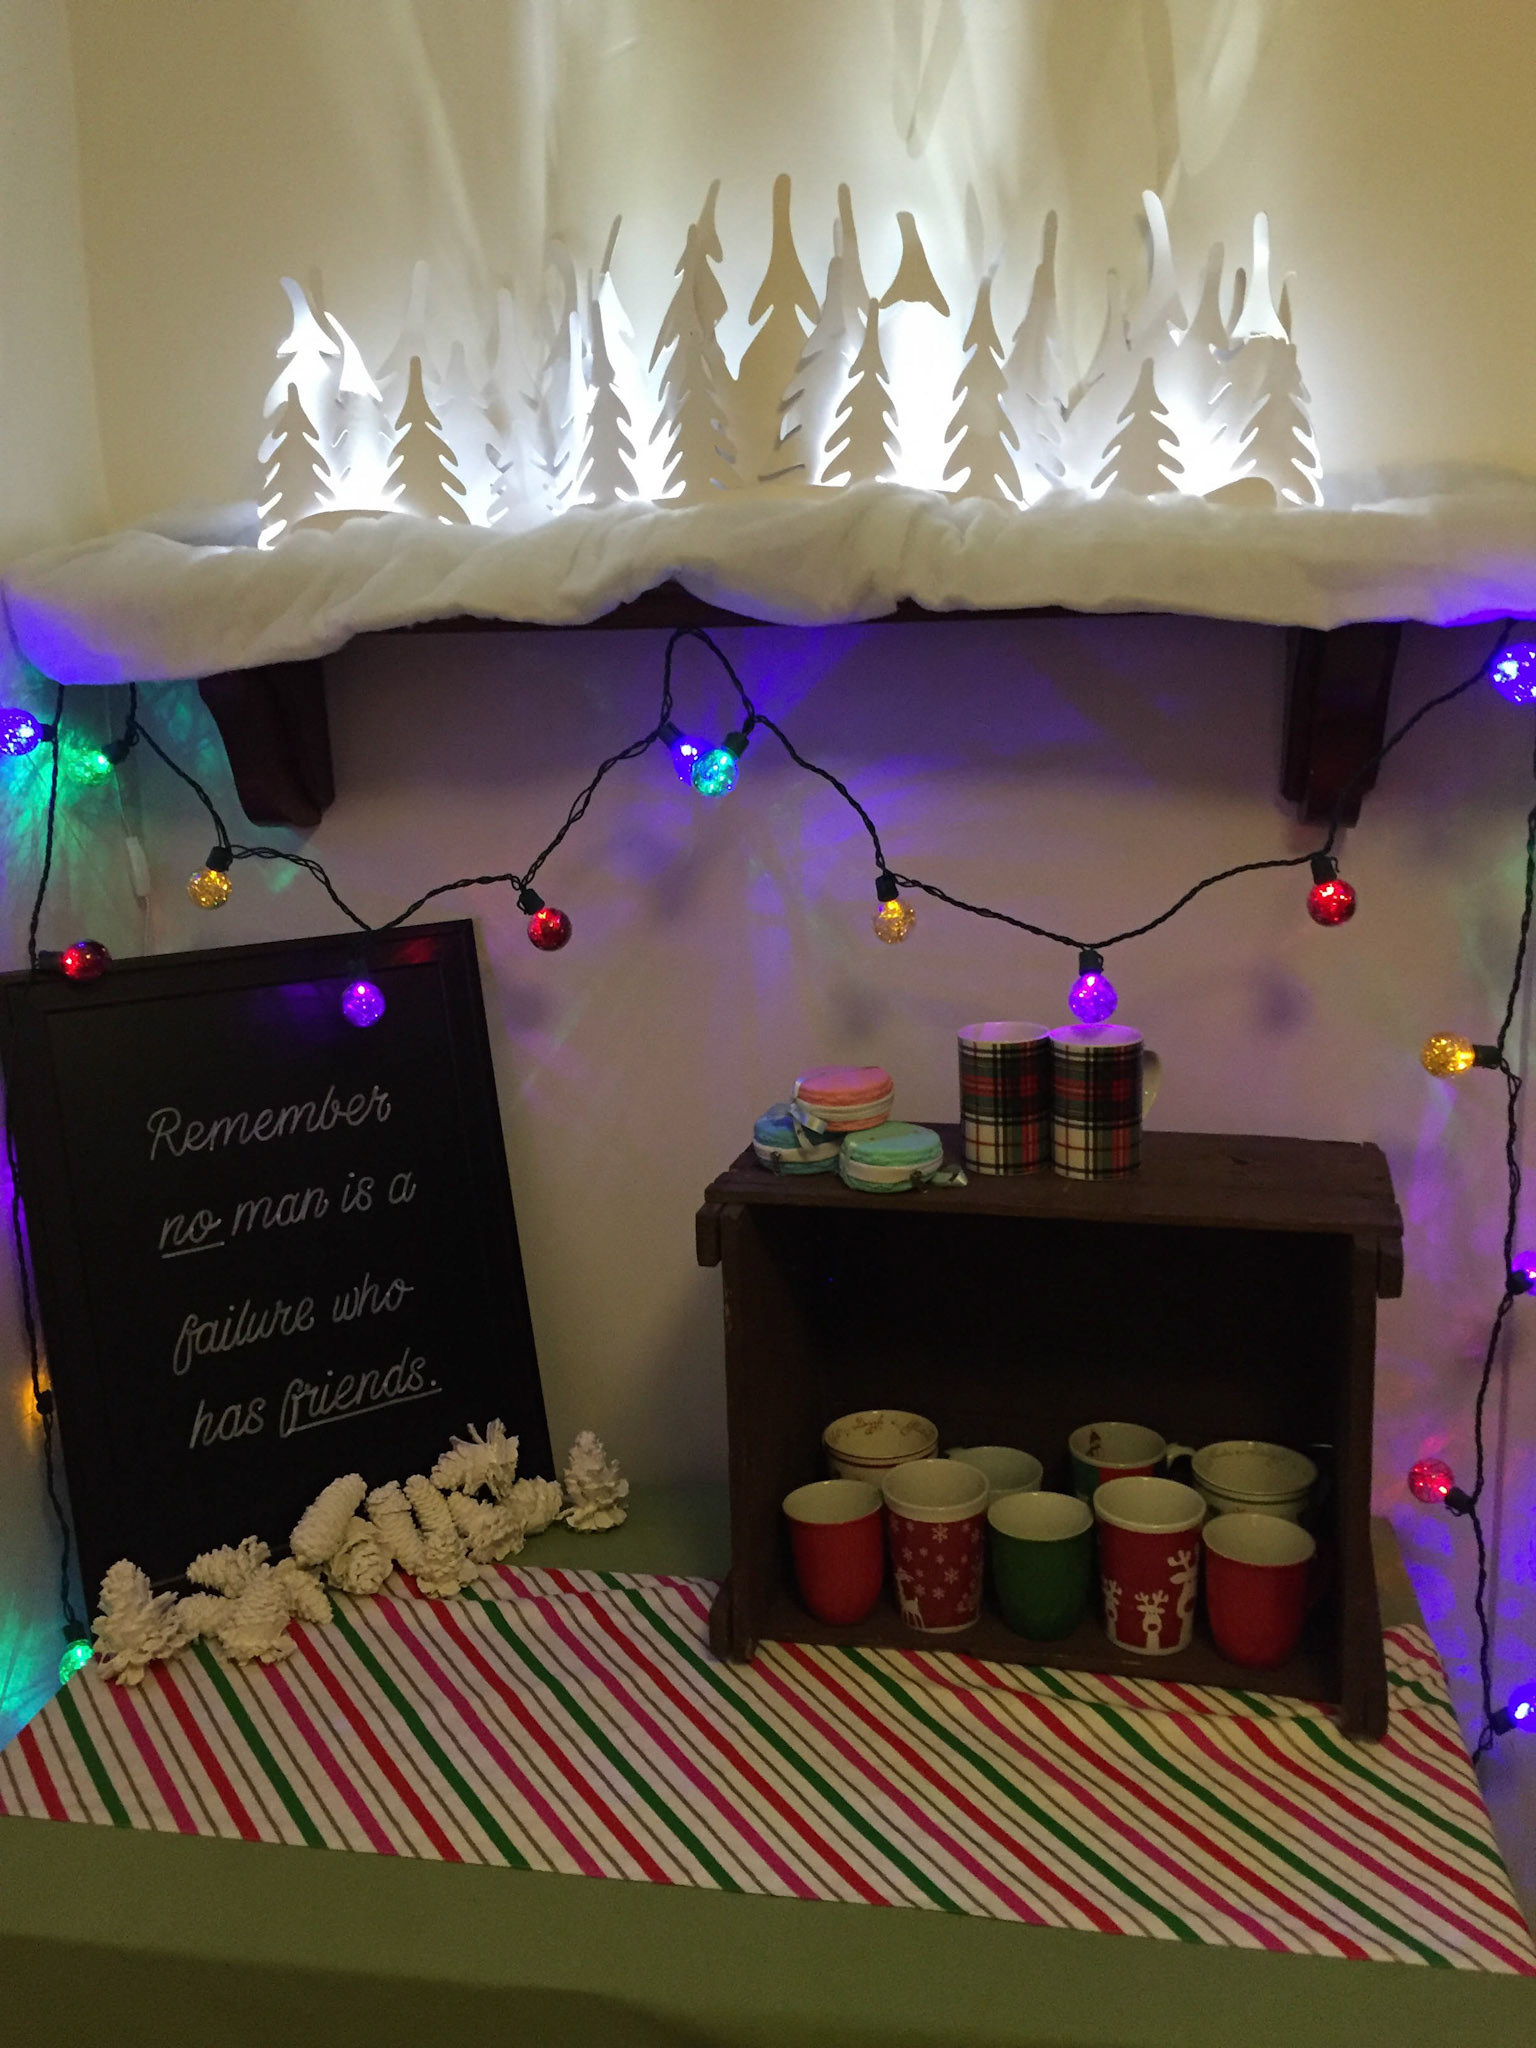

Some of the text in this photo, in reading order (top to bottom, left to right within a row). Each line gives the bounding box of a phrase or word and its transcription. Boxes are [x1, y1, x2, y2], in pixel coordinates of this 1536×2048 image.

[147, 1085, 391, 1160] Remember
[158, 1171, 417, 1251] no man is a
[173, 1272, 414, 1376] failure who
[189, 1347, 438, 1449] has friends.
